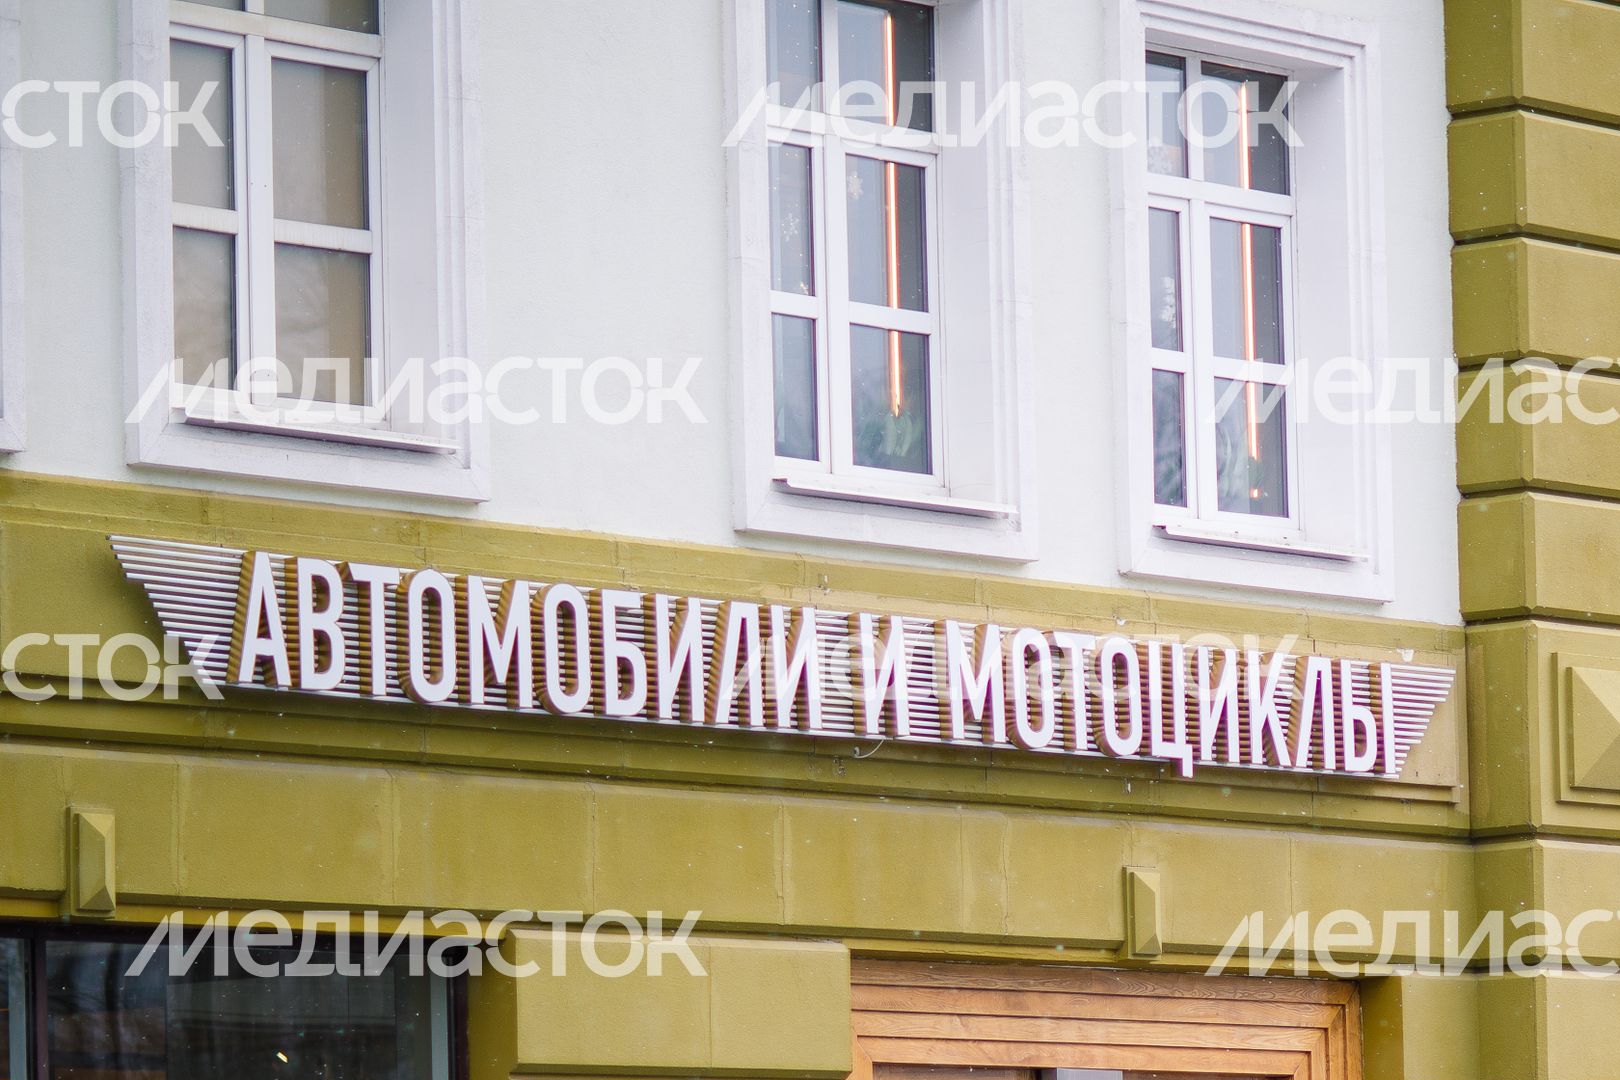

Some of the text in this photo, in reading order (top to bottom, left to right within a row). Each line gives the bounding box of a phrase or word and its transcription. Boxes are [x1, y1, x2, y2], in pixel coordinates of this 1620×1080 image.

[234, 551, 1396, 778] АВТОМОБИЛИ И МОТОЦИКЛЫ
